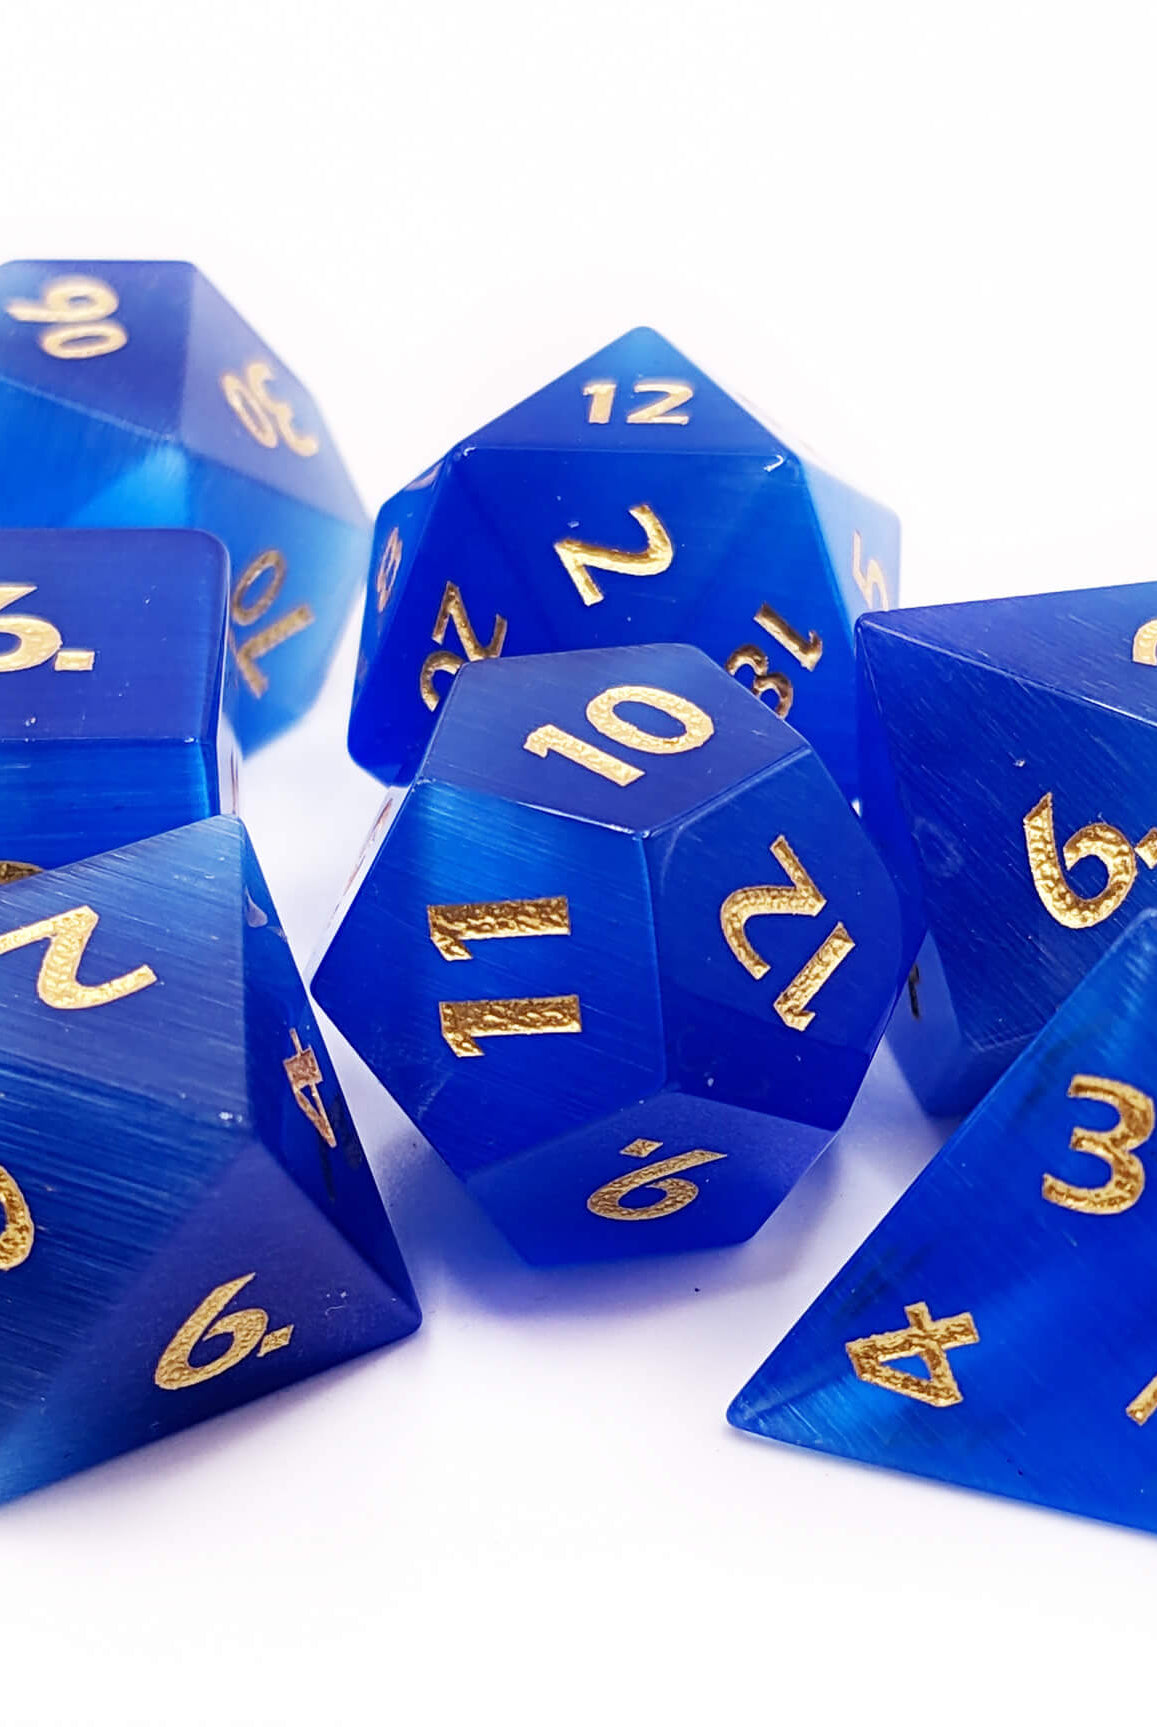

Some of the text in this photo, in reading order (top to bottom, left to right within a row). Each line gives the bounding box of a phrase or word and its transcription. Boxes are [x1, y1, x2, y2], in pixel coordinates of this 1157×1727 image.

[221, 362, 319, 457] 30
[582, 380, 694, 424] 12
[553, 504, 673, 606] 2
[523, 685, 715, 787] 10
[0, 905, 157, 1010] 2
[427, 896, 582, 1058] 11
[720, 835, 856, 1031] 12
[283, 1027, 335, 1149] 4
[587, 1138, 728, 1221] 6.
[1042, 1074, 1155, 1215] 3
[154, 1272, 294, 1391] 6.
[845, 1301, 980, 1408] 4
